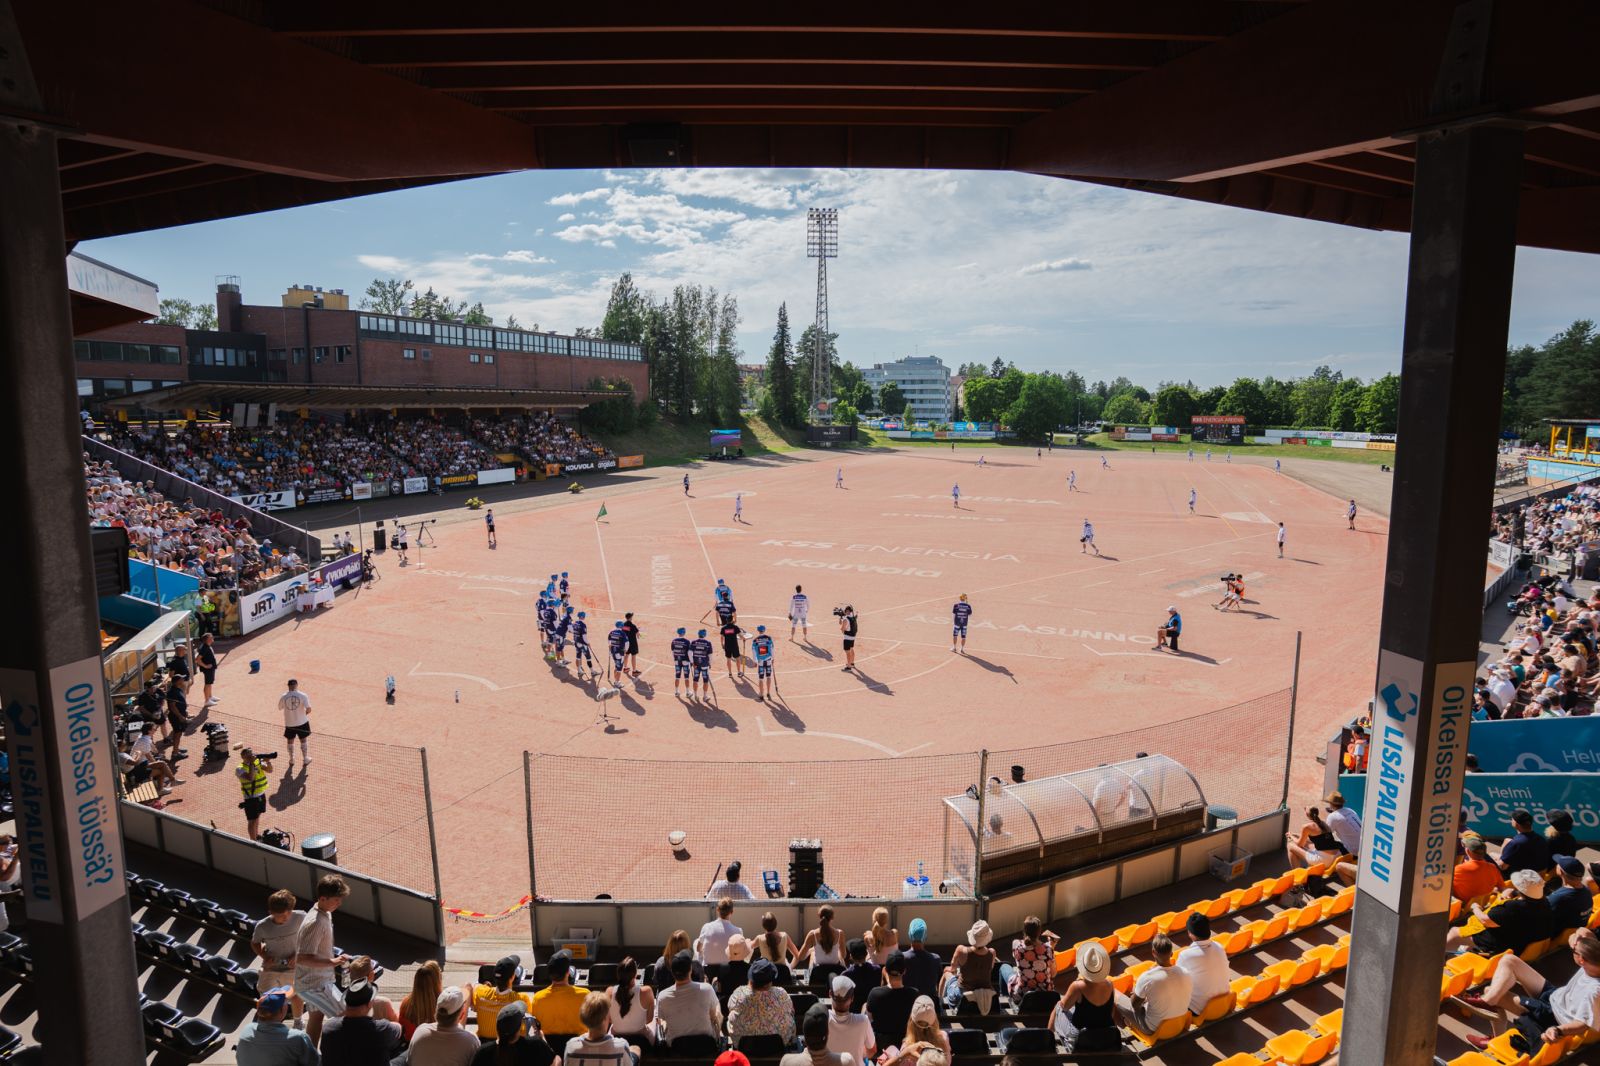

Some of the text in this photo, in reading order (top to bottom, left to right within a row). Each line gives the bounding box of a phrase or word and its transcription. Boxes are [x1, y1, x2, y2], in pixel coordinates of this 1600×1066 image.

[565, 462, 595, 471] KOUVOLA
[760, 539, 1022, 563] KSS ENERGIA
[250, 597, 274, 617] JRT
[16, 744, 52, 902] LISÄPALVELU
[65, 682, 114, 888] Oikeissa töissä?
[1370, 724, 1406, 884] LISÄPALVELU
[1422, 685, 1465, 892] Oikeissa töissä?
[1488, 786, 1533, 799] Helmi
